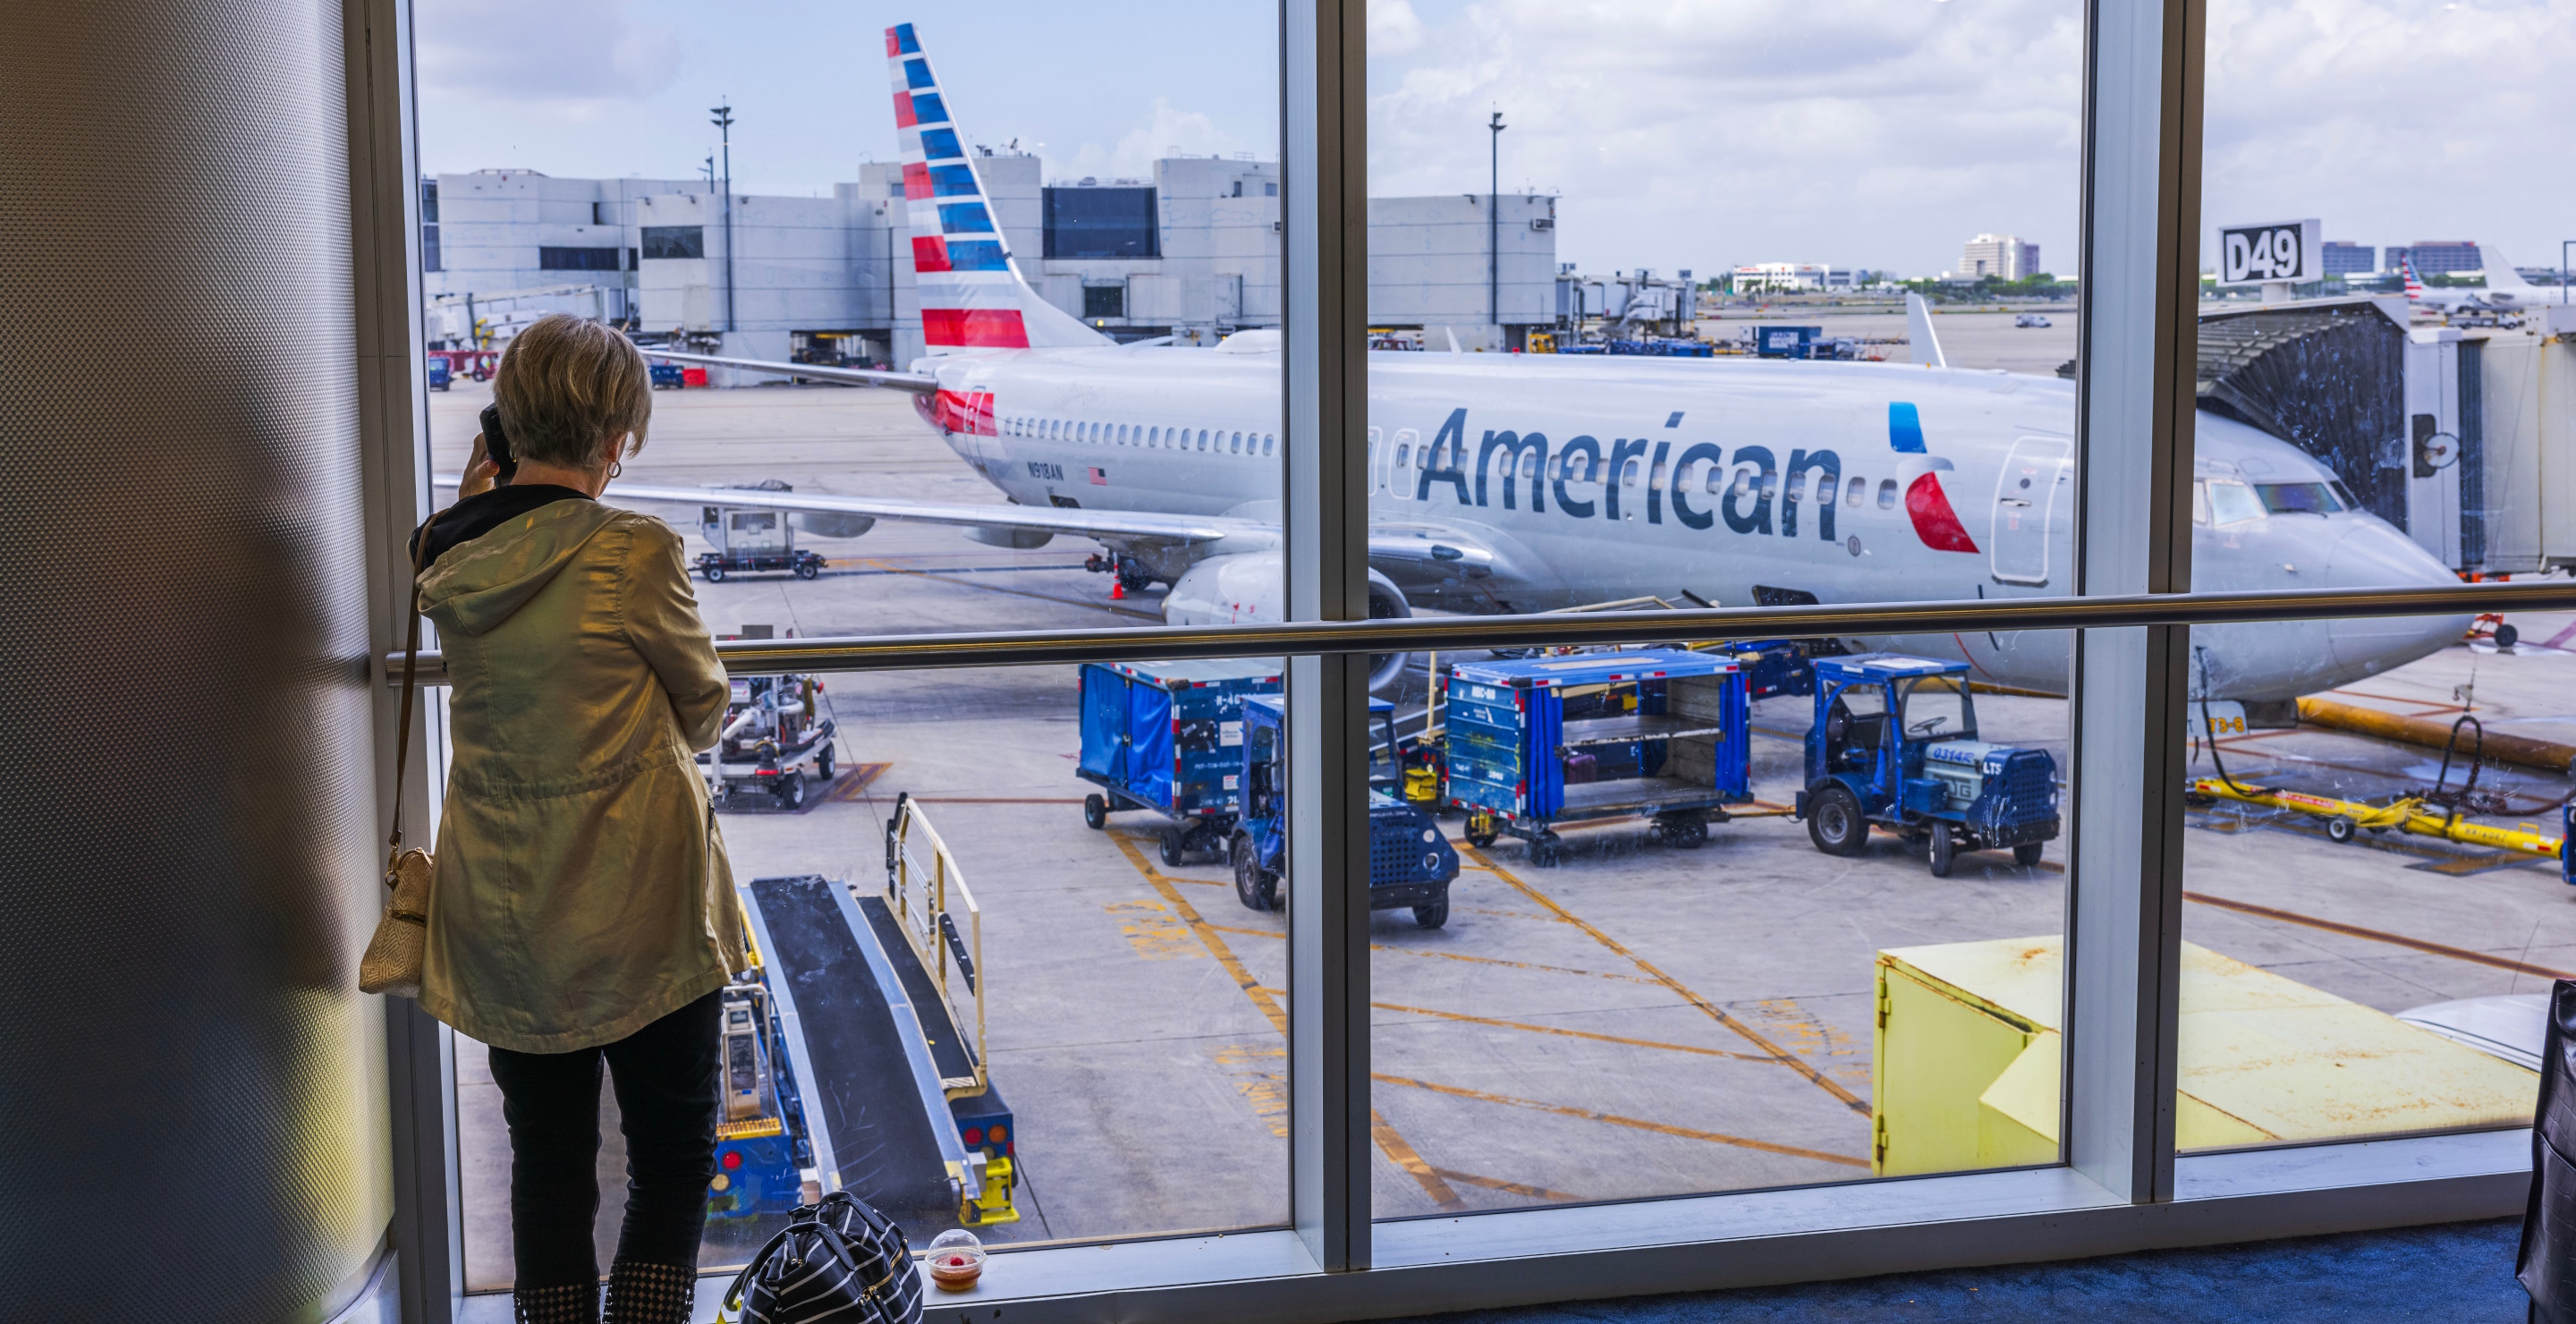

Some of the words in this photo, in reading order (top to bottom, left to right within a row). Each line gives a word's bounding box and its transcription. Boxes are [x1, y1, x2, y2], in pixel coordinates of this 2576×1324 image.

[2224, 229, 2299, 282] D49
[1028, 461, 1064, 481] N918AN
[1417, 407, 1841, 541] American
[1983, 761, 2002, 776] LTS
